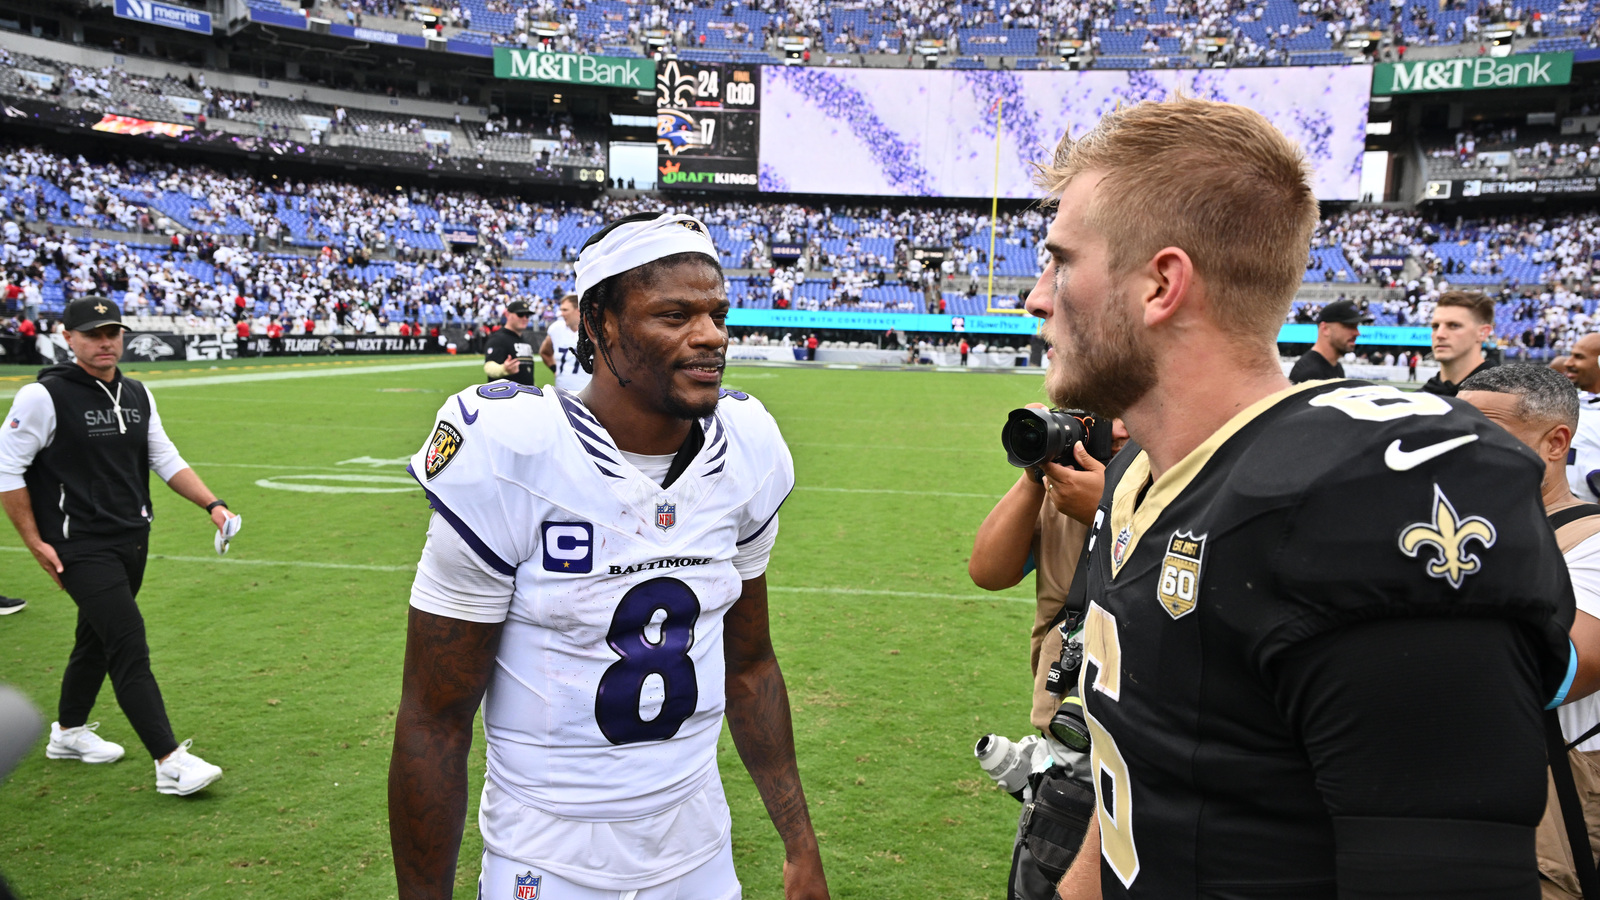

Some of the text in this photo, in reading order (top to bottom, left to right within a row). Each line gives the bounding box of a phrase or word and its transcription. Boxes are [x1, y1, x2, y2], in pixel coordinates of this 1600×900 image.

[154, 6, 201, 25] merritt
[510, 50, 641, 86] M&T Bank
[1391, 54, 1552, 91] M&T Bank
[698, 70, 719, 97] 24
[726, 82, 755, 105] 0:00
[700, 118, 716, 144] 17
[662, 171, 757, 185] DRAFTKINGS
[284, 338, 321, 352] FLIGHT
[356, 338, 384, 351] NEXT
[440, 422, 461, 443] RAVENS
[659, 513, 674, 527] NFL
[546, 526, 589, 560] C
[608, 557, 712, 575] BALTIMORE
[1161, 564, 1196, 602] 60
[594, 576, 701, 746] 8
[517, 885, 536, 899] NFL
